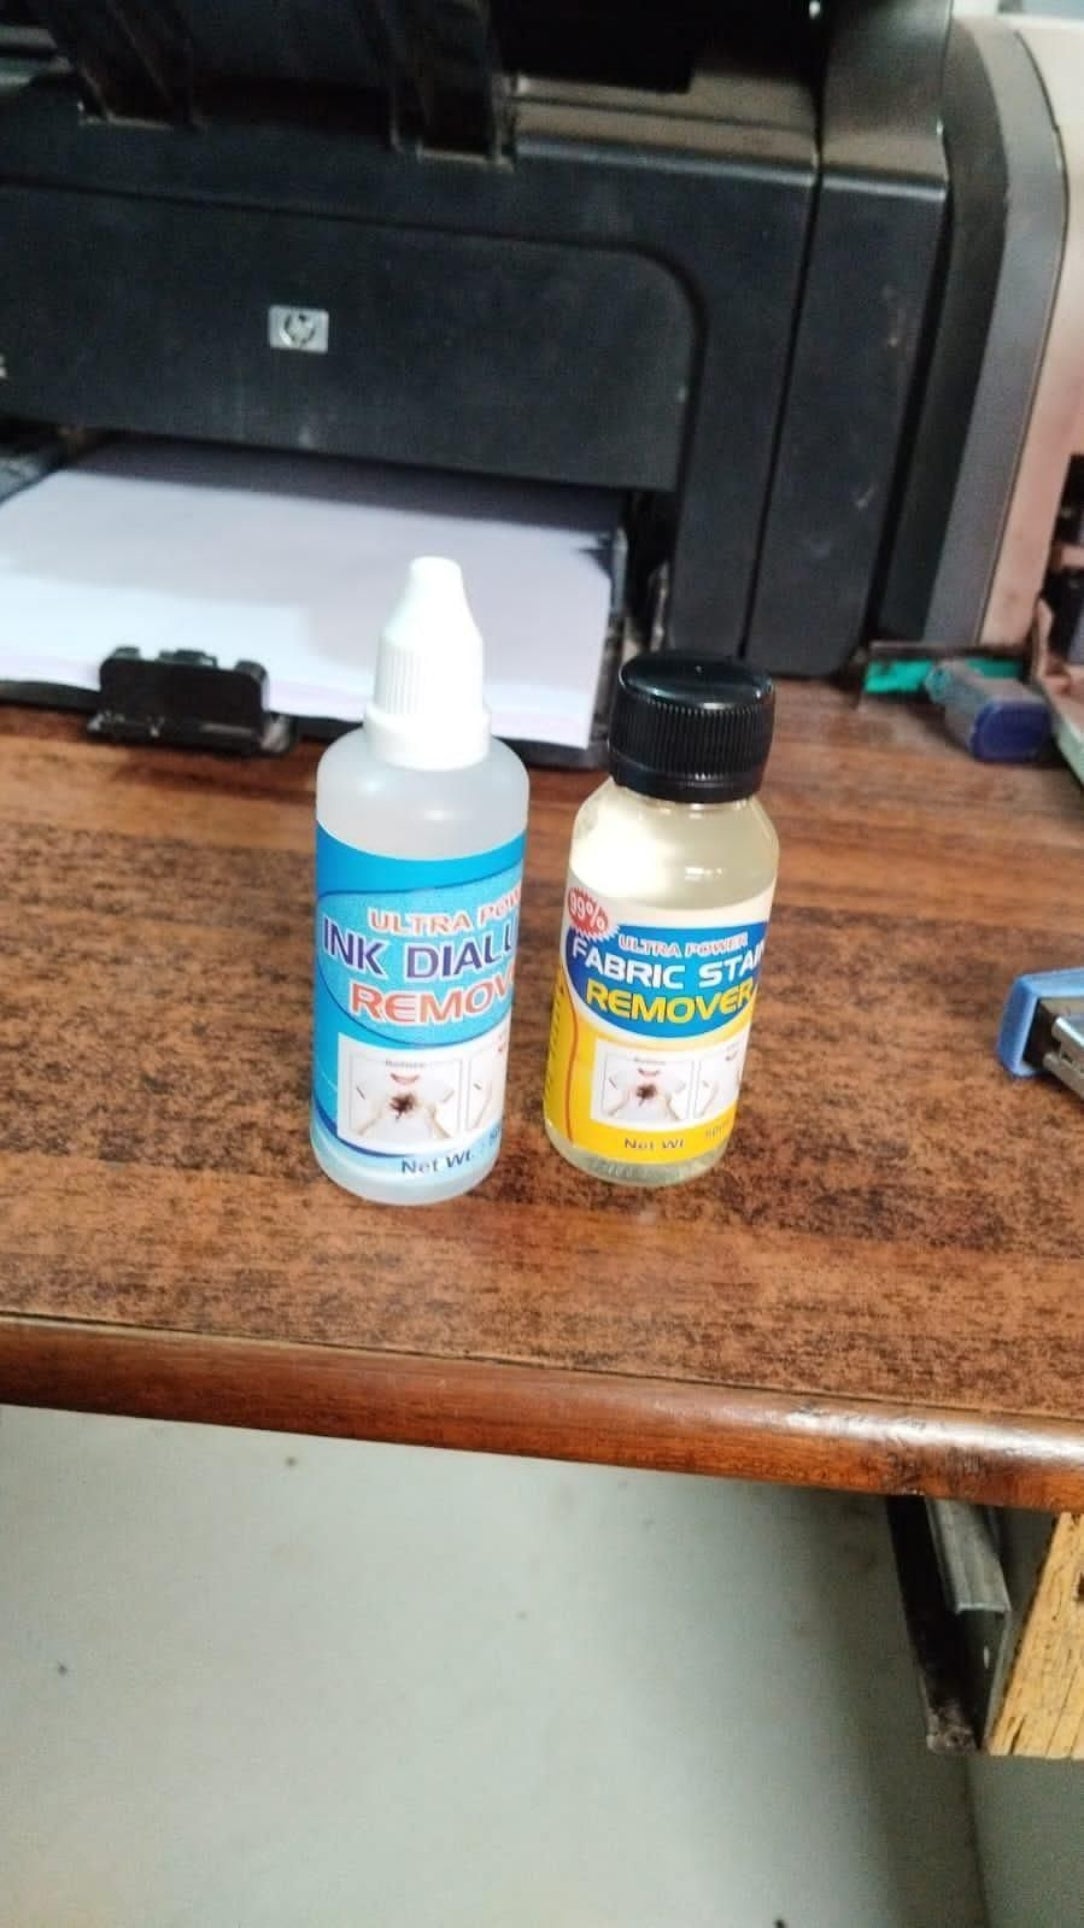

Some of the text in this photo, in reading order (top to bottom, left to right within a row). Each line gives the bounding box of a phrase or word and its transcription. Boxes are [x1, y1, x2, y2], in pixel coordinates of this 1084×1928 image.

[369, 909, 472, 935] ULTRA
[569, 891, 606, 931] 99%
[323, 917, 387, 977] INK
[619, 932, 748, 959] ULTRA POWER
[572, 937, 686, 990] FABRIC
[586, 978, 754, 1024] REMOVER
[625, 1137, 654, 1150] Net
[400, 1158, 439, 1175] Net
